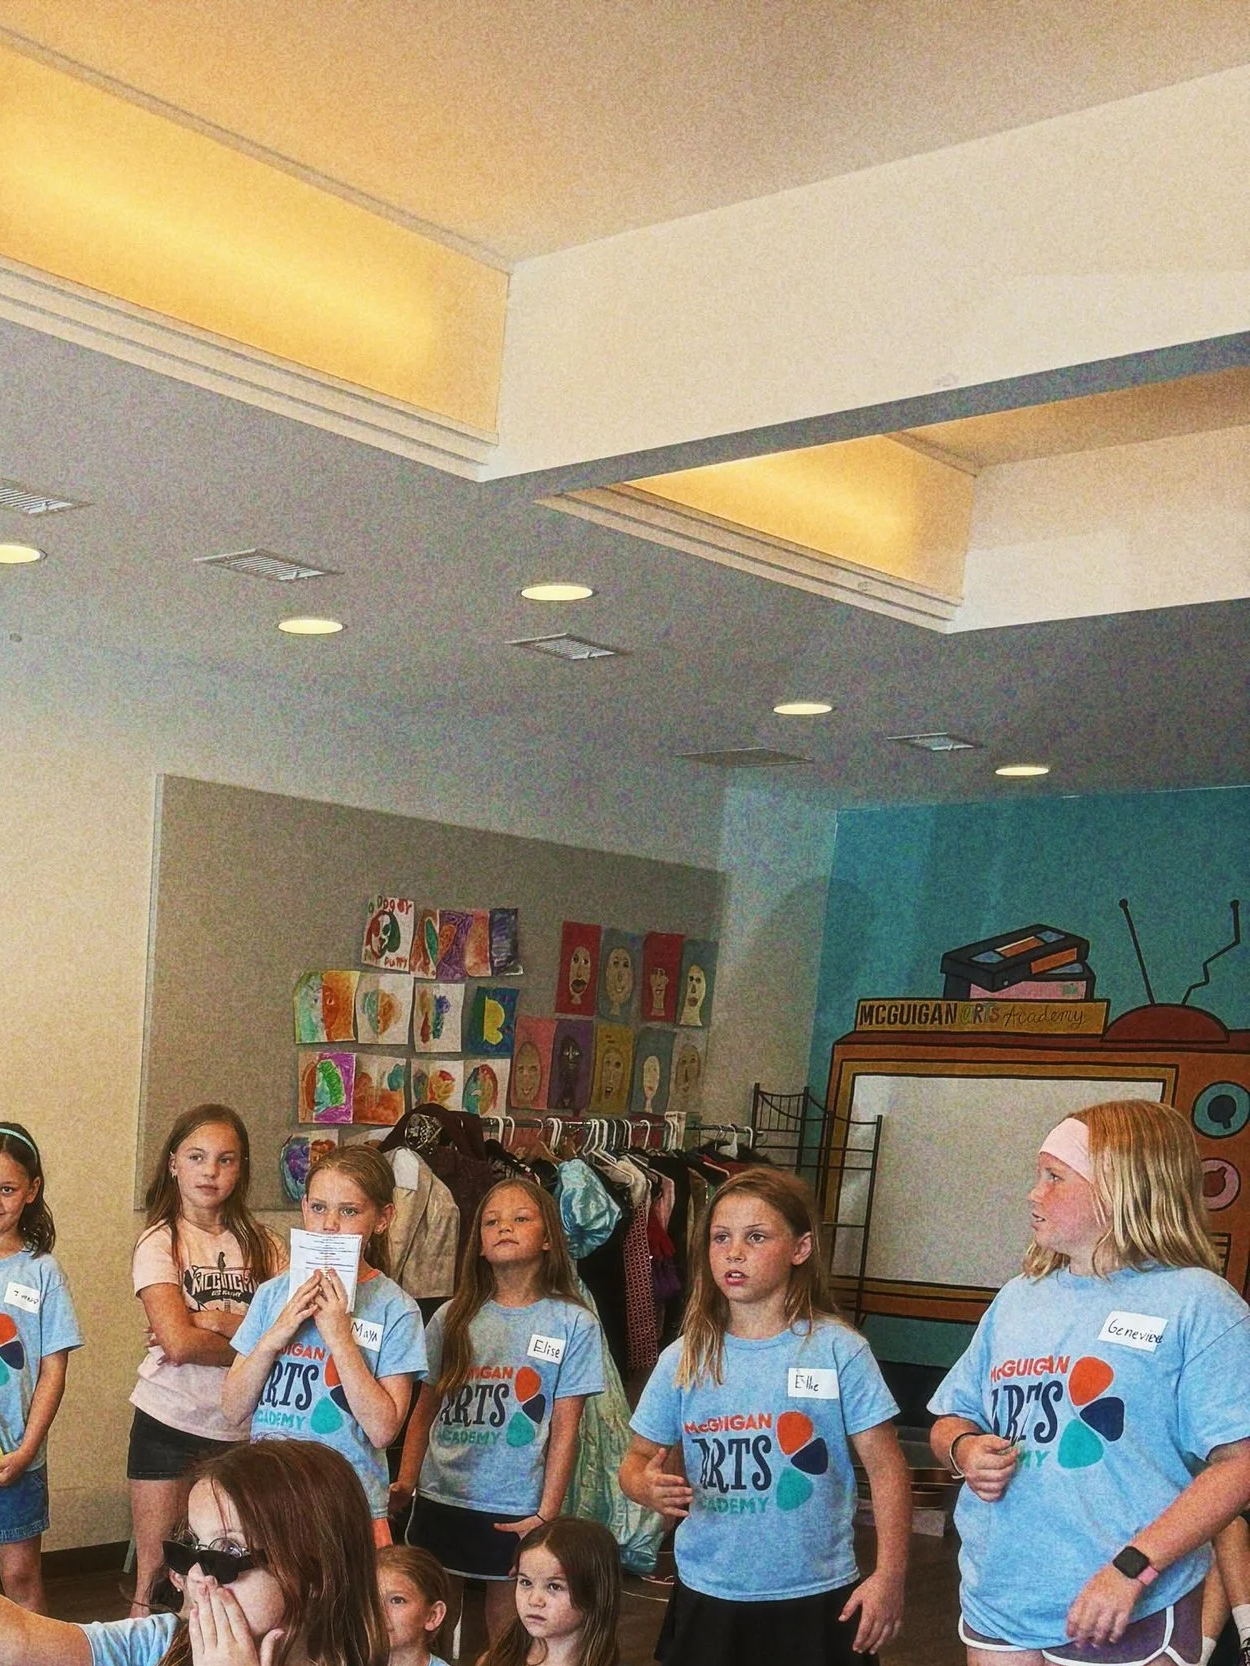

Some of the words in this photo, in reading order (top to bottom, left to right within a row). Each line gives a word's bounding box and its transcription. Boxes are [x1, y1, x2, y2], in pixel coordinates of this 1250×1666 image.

[859, 1003, 957, 1026] MCGUIGAN
[533, 1339, 560, 1359] Elise
[259, 1361, 319, 1411] RTS
[256, 1408, 306, 1430] CADEMY
[702, 1496, 769, 1514] ADEMY
